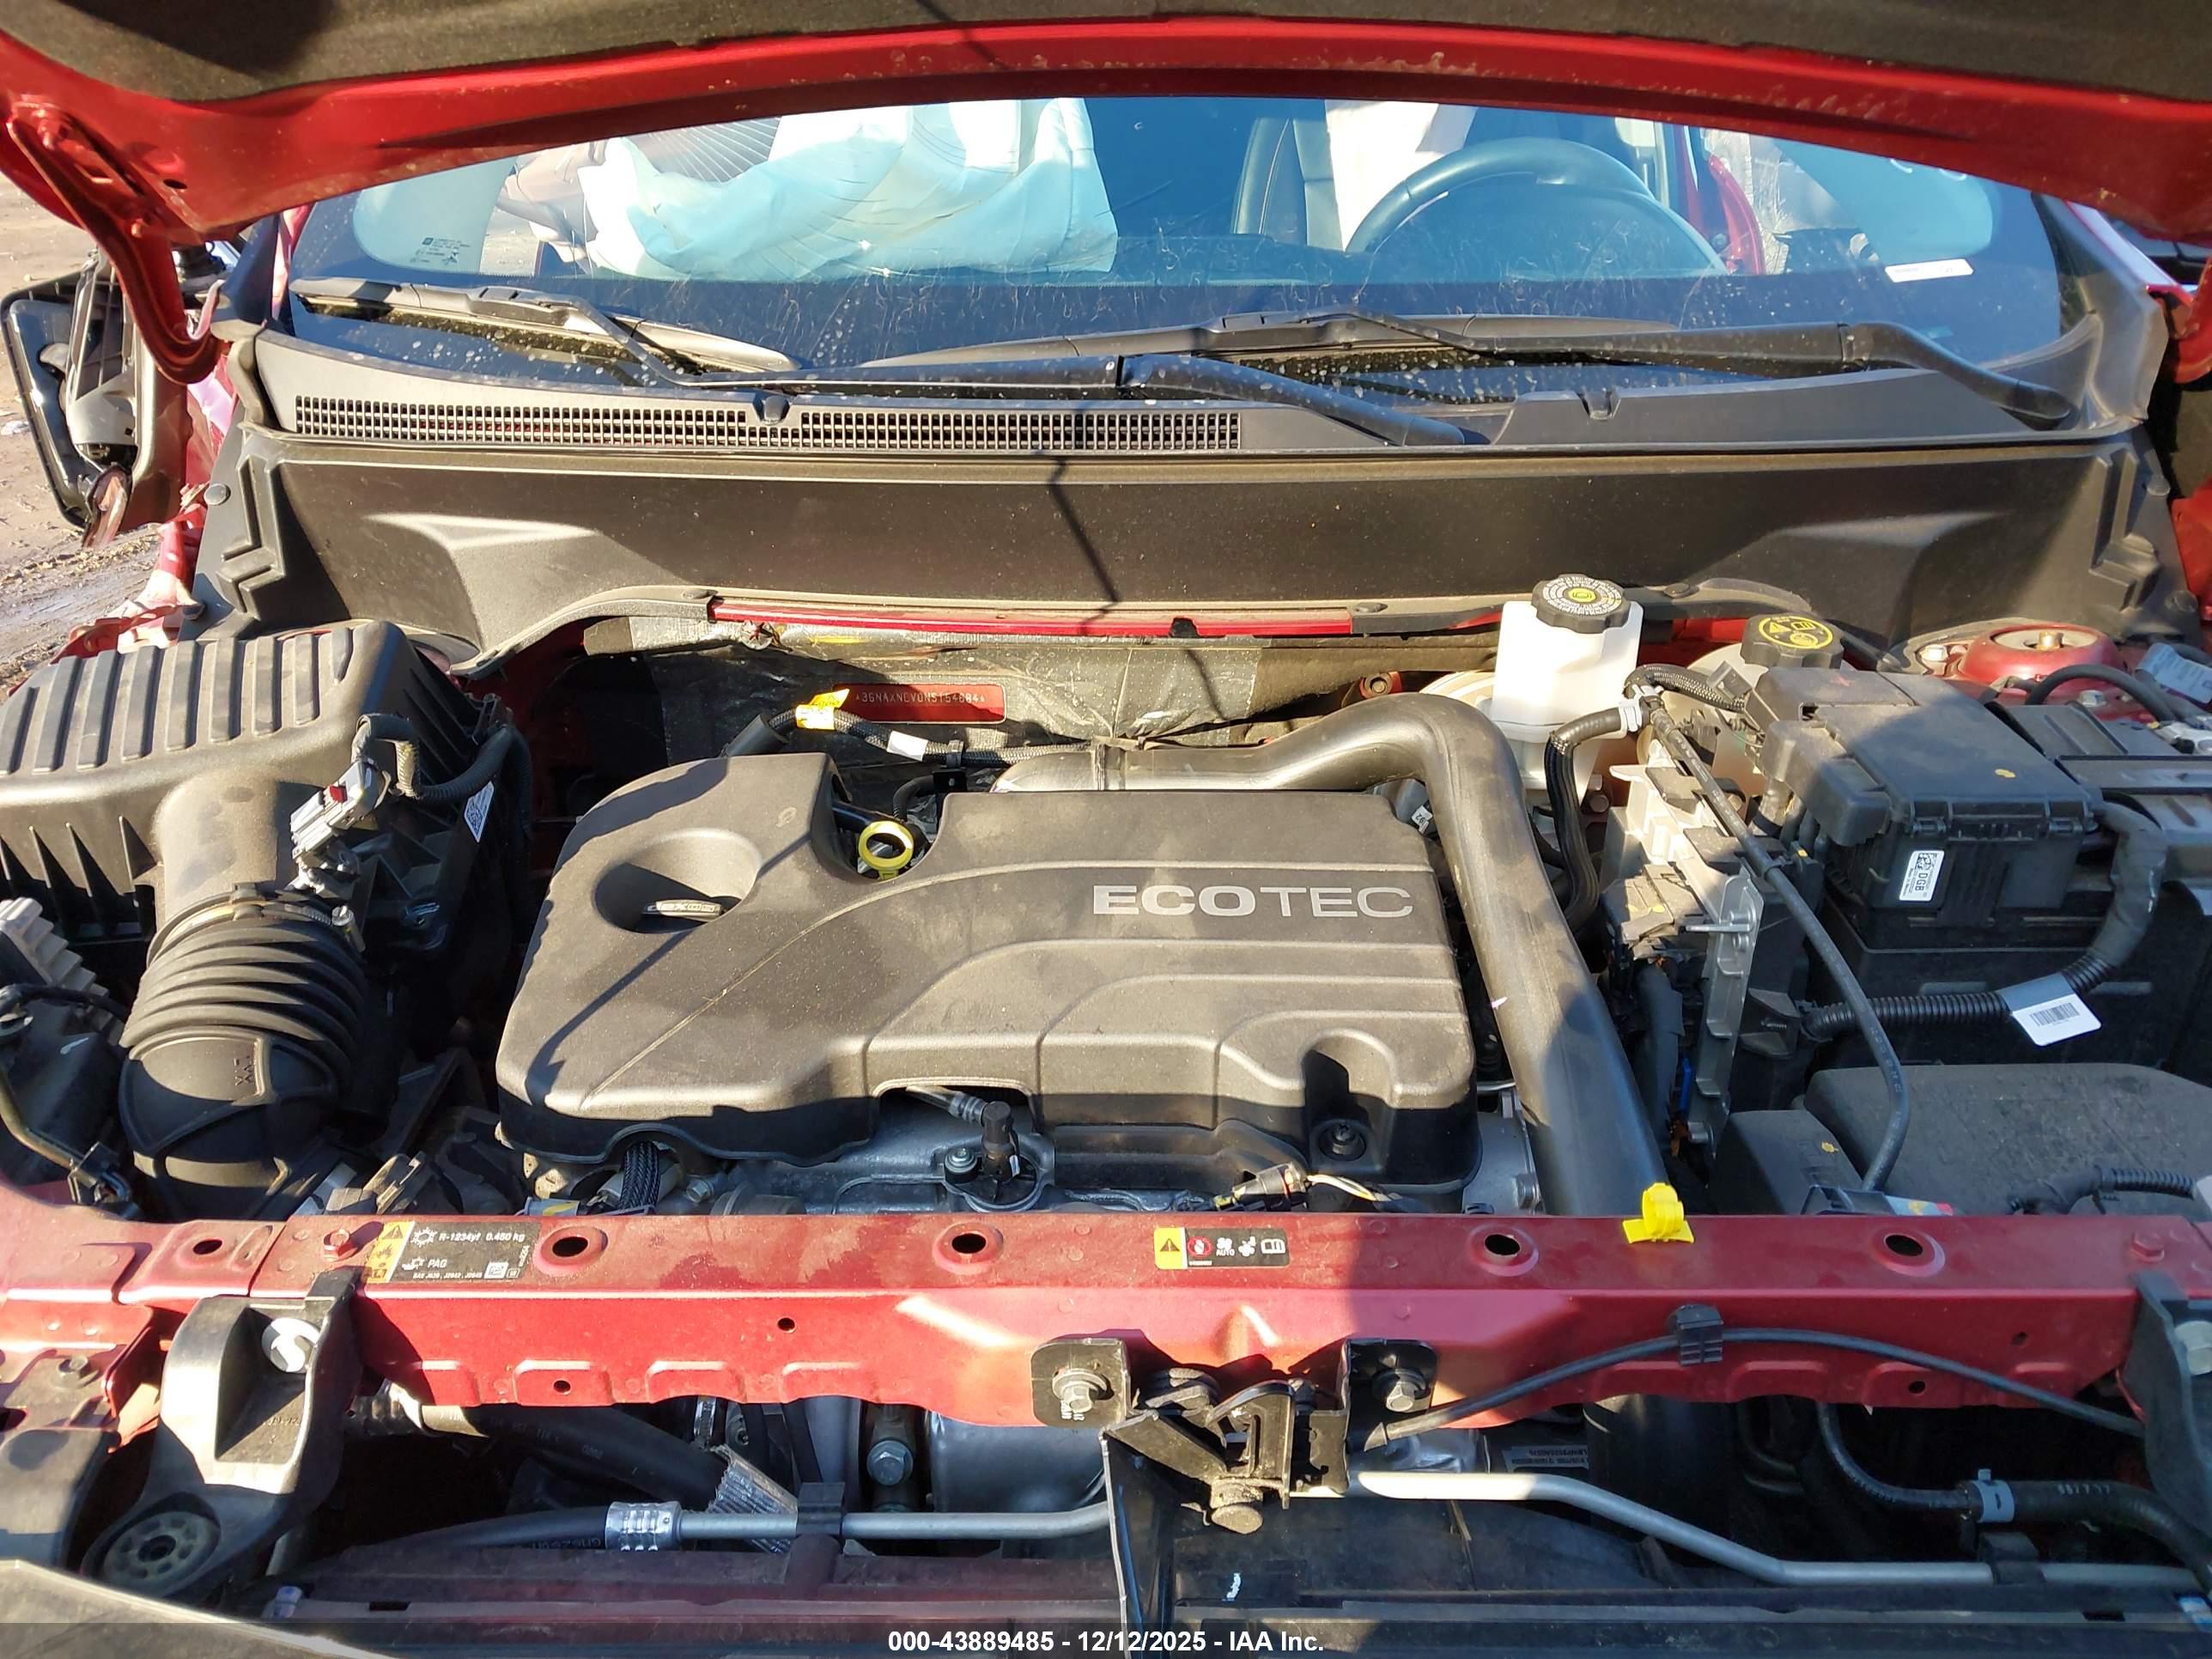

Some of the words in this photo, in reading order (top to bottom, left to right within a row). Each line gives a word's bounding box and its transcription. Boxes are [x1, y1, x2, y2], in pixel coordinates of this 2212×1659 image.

[1915, 872, 1929, 891] DGB
[1092, 884, 1413, 918] ECOTEC
[427, 1259, 447, 1268] PAG
